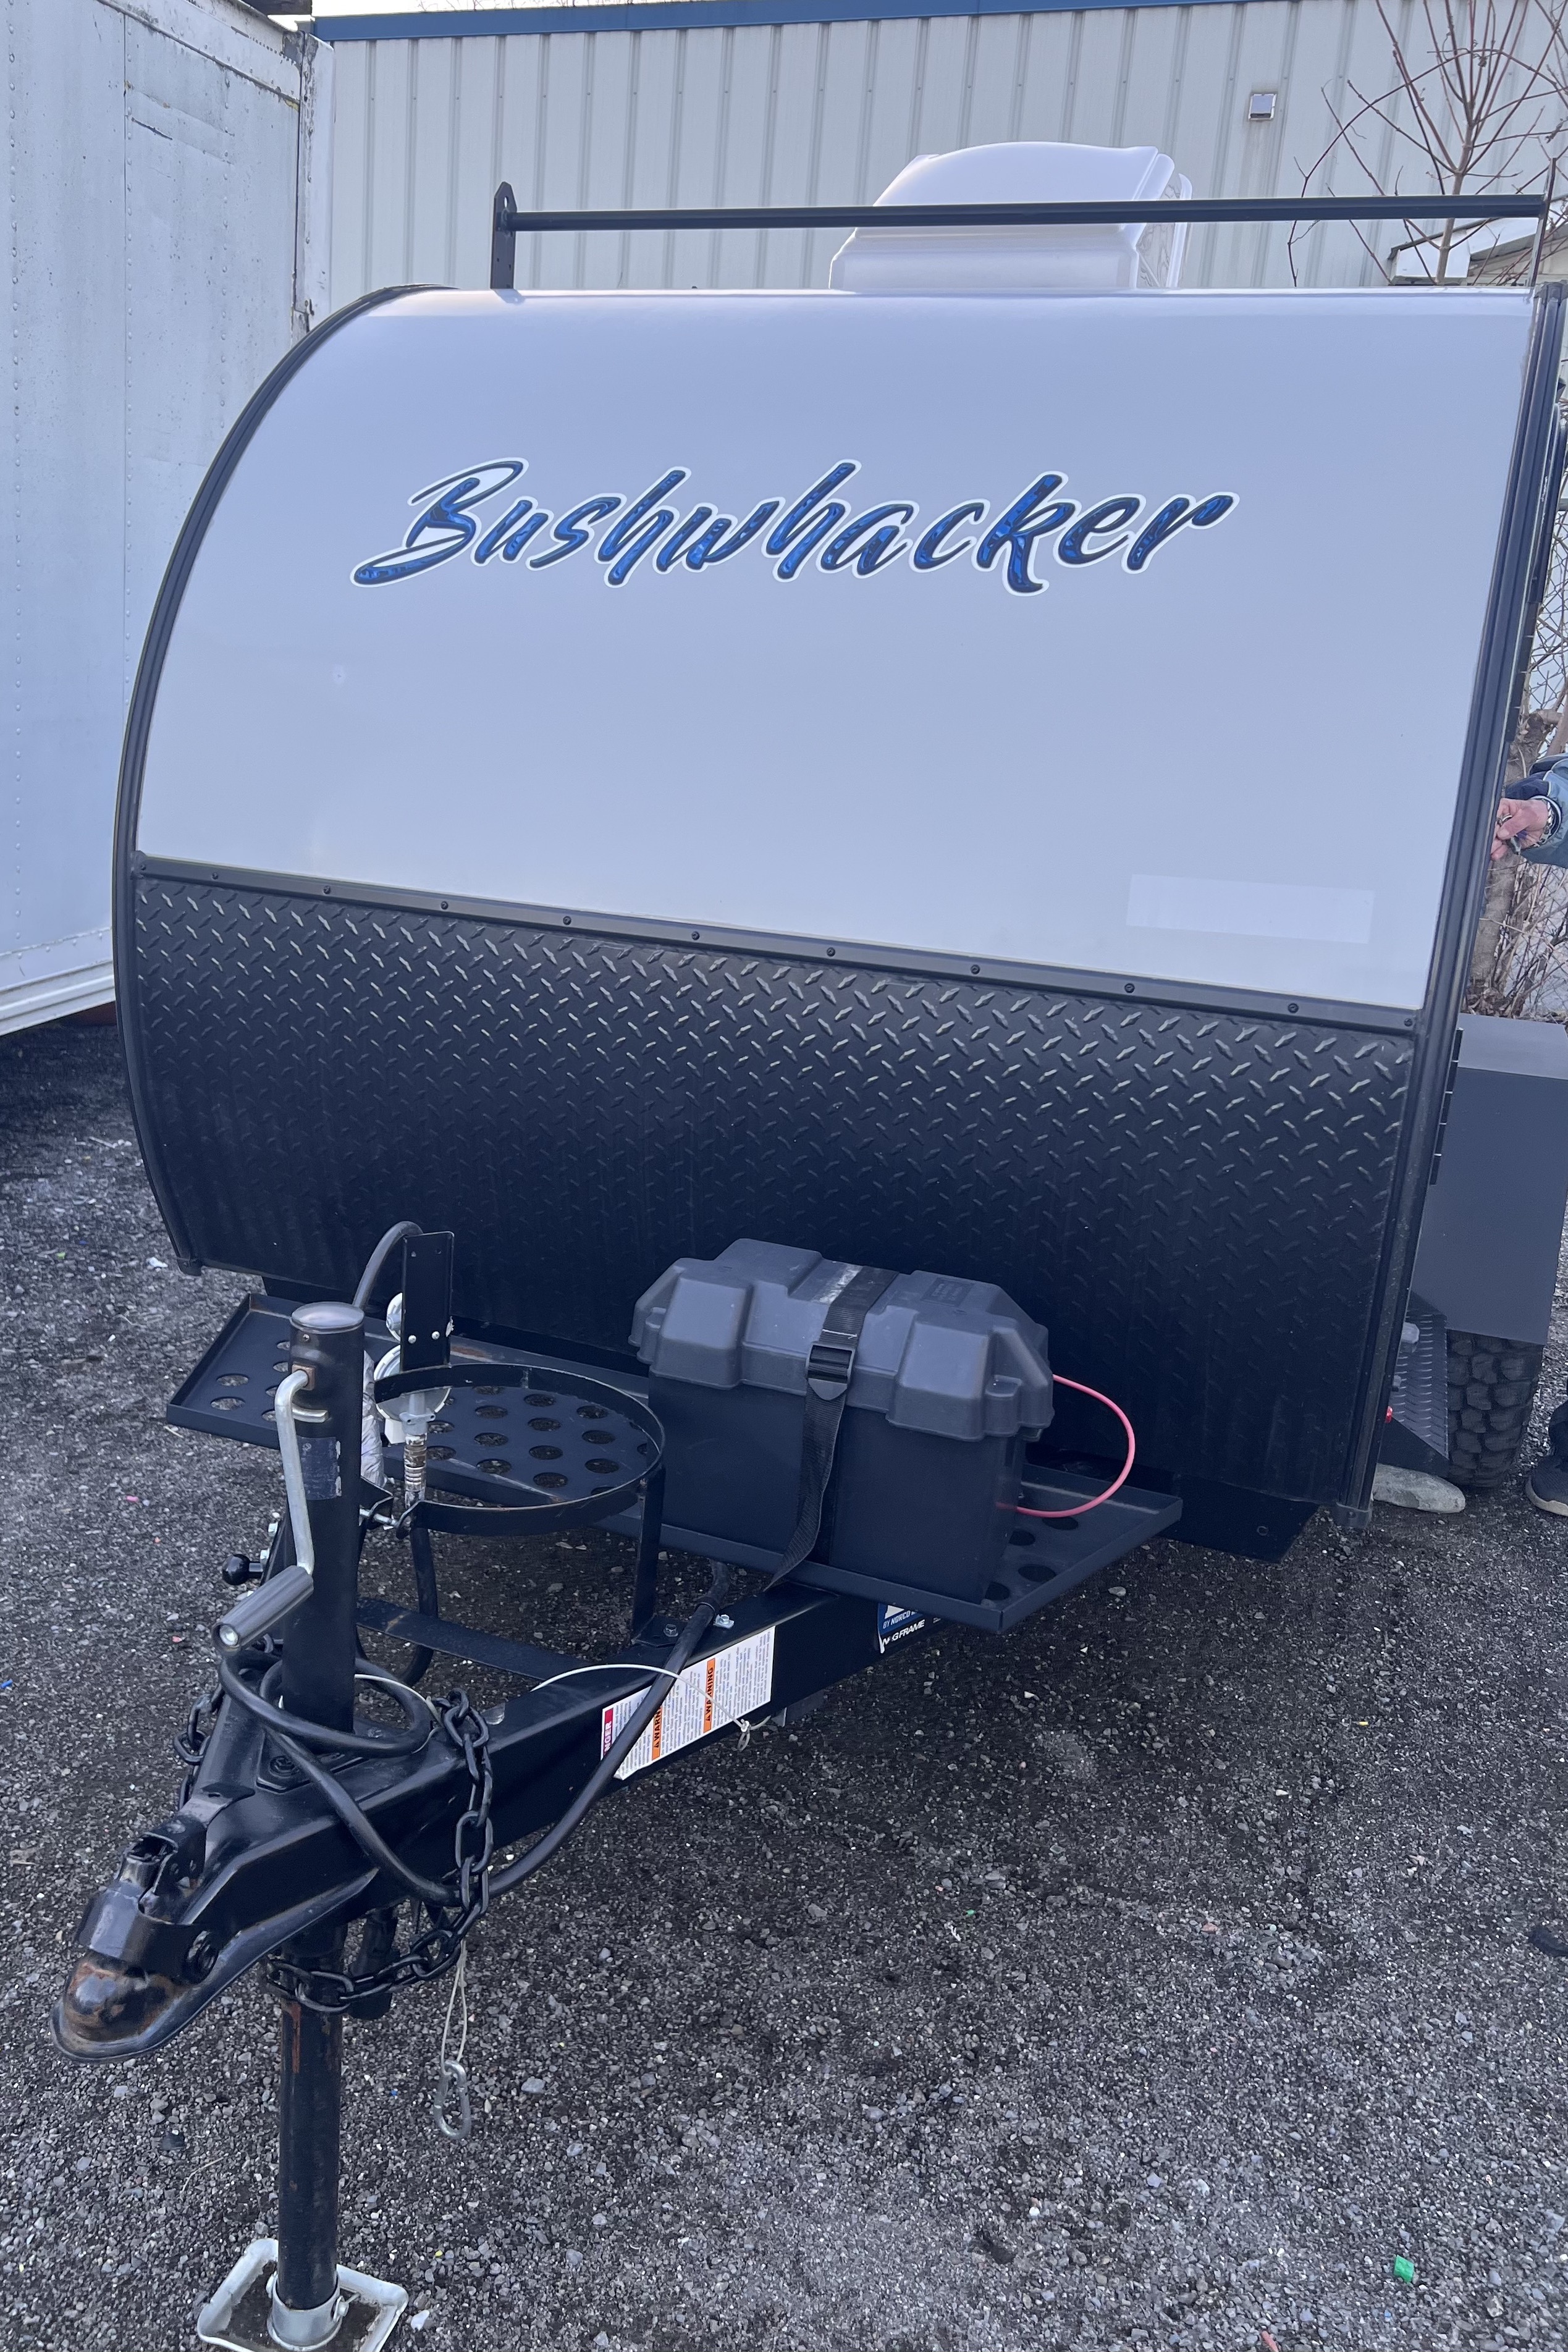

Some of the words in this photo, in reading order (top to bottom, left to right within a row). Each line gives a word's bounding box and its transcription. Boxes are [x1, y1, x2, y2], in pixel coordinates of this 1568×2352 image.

[352, 458, 1238, 595] Bushwhacker
[891, 1610, 911, 1625] NORCO
[604, 1721, 612, 1754] NGER
